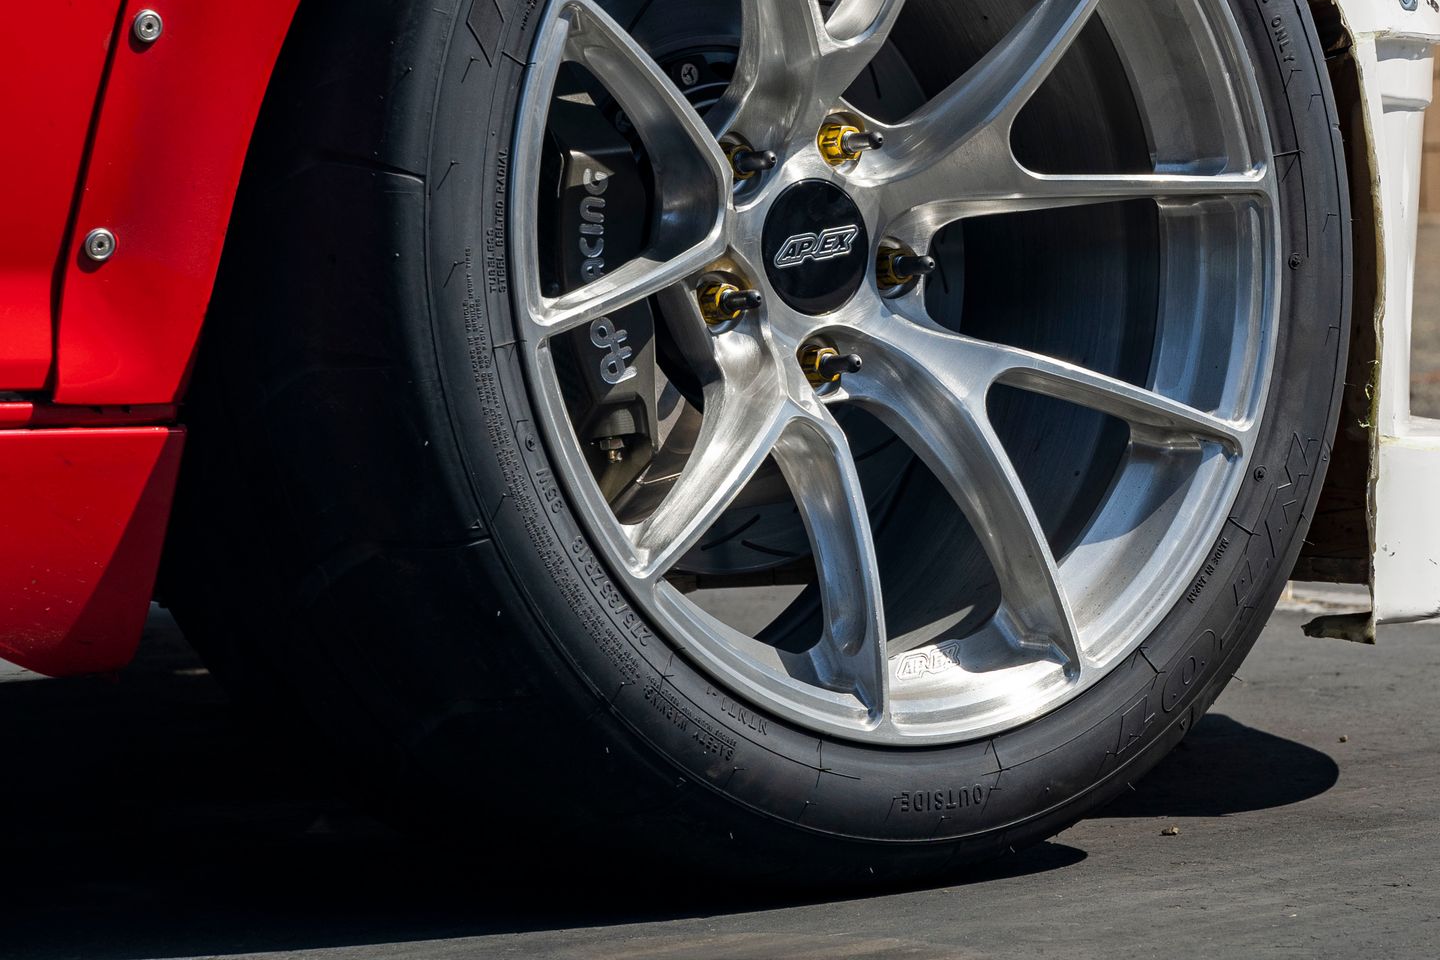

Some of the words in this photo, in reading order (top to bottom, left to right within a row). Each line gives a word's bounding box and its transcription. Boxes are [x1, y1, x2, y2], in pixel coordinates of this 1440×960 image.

[1270, 15, 1294, 64] ONLY
[496, 147, 508, 195] RADIAL
[579, 167, 609, 285] ACING
[777, 226, 855, 265] APEX
[497, 253, 506, 294] STEEL
[536, 467, 563, 513] 95W
[1204, 563, 1214, 577] IN
[1211, 536, 1229, 565] MADE
[570, 538, 651, 647] 275/35ZR18
[1186, 575, 1207, 604] JAPAN
[899, 643, 959, 679] APEX
[693, 728, 732, 762] SAFETY
[900, 786, 984, 809] OUTSIDE
